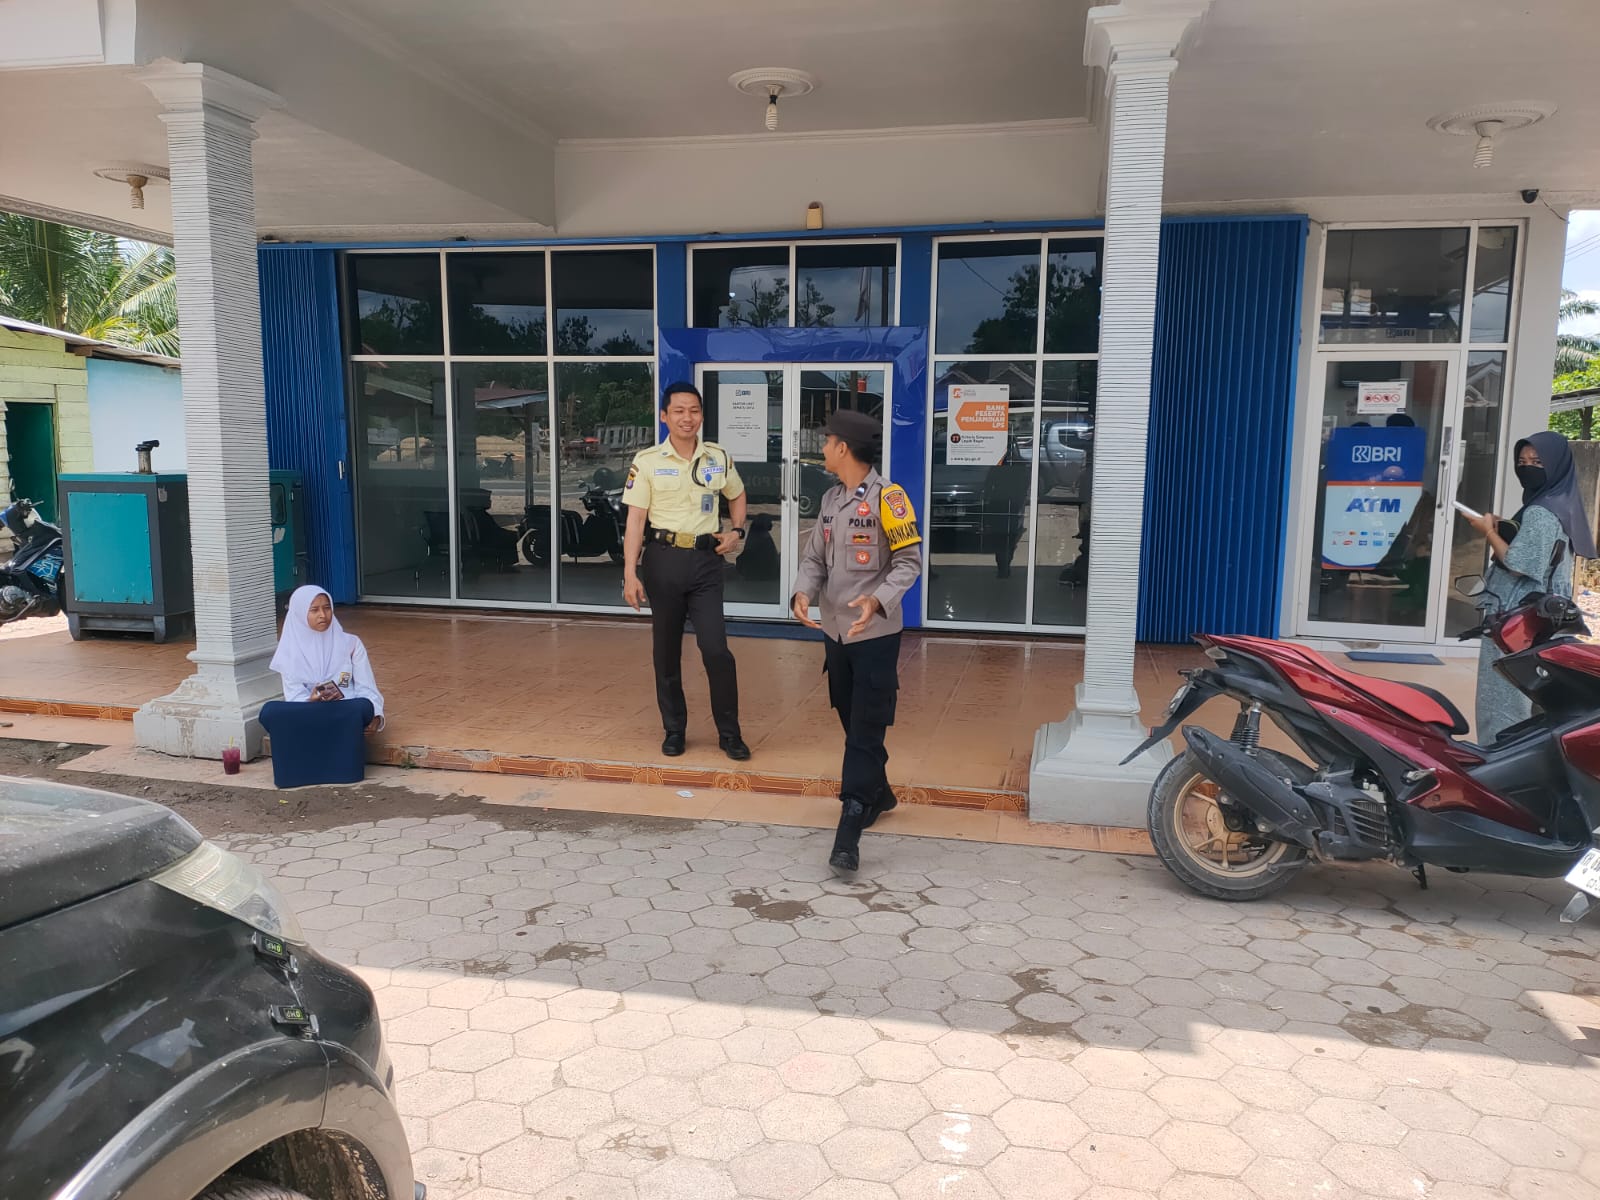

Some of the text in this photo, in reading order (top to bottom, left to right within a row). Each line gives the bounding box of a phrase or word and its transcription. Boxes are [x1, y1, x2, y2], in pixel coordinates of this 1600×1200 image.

[1371, 446, 1402, 462] BRI
[1345, 497, 1401, 513] ATM
[848, 518, 876, 528] POLRI
